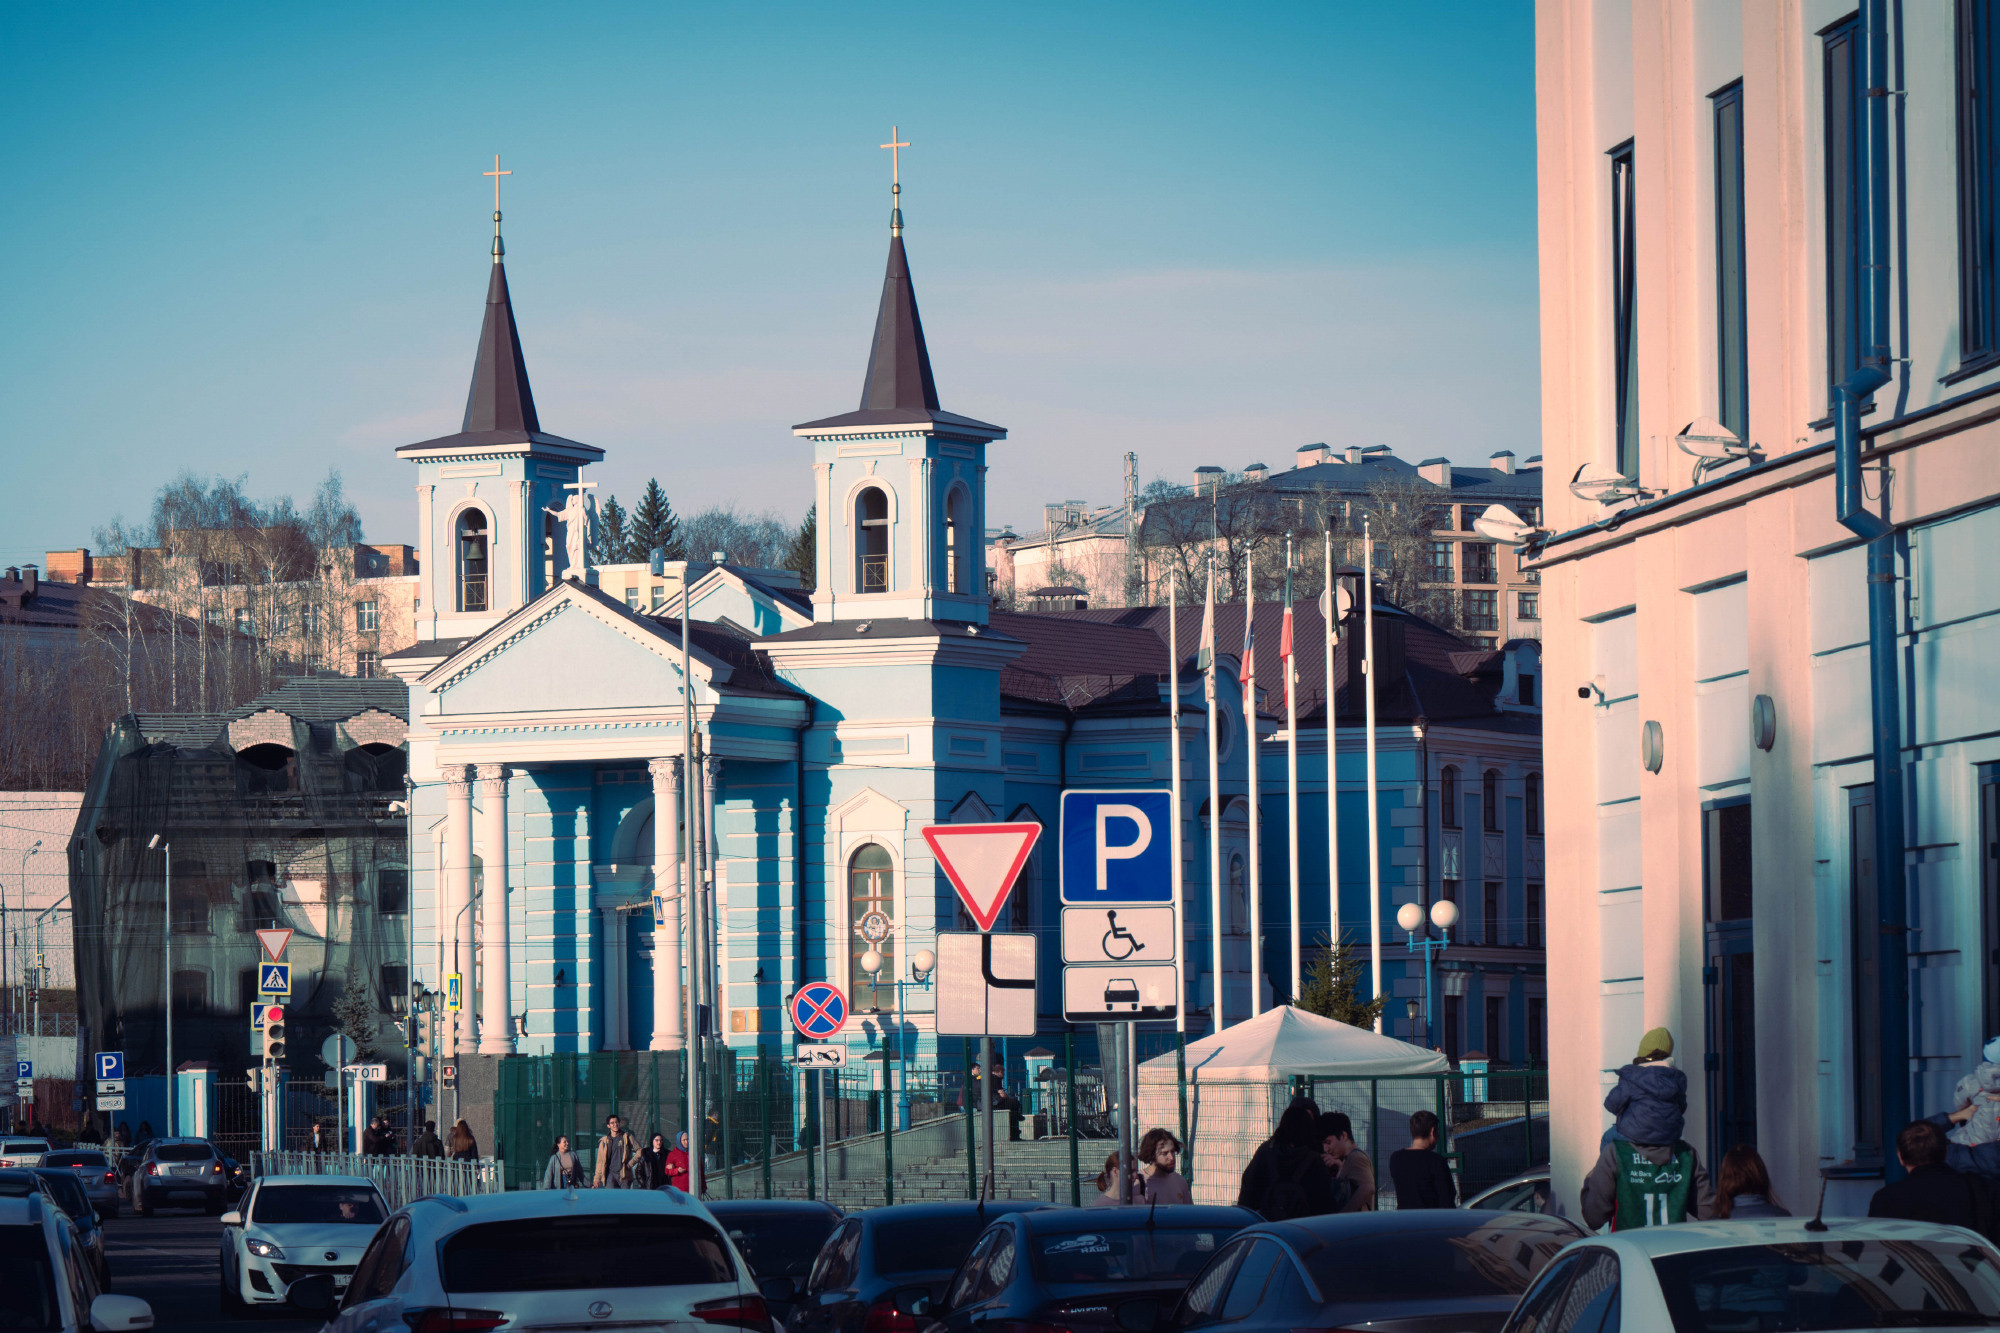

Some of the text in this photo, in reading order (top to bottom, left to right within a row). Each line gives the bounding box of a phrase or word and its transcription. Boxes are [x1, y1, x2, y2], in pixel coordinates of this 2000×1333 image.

[1096, 804, 1152, 890] P
[19, 1063, 29, 1077] P
[102, 1055, 117, 1077] P
[1643, 1193, 1669, 1227] 11
